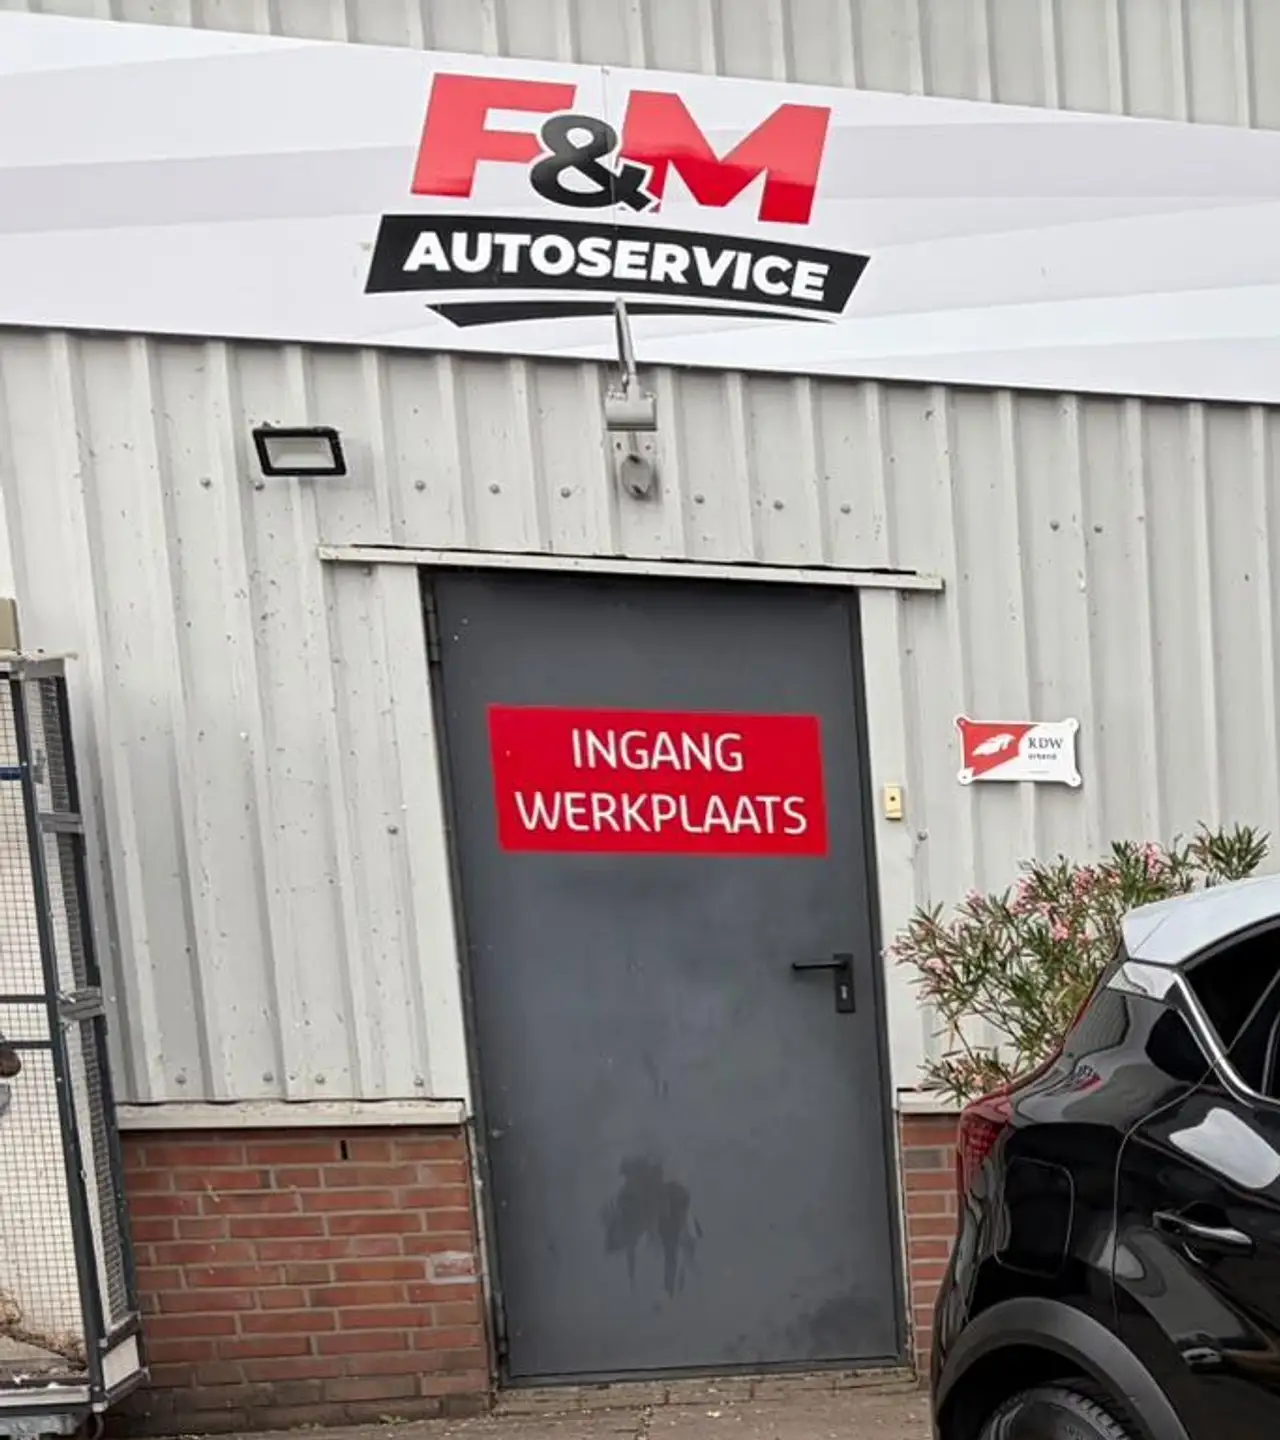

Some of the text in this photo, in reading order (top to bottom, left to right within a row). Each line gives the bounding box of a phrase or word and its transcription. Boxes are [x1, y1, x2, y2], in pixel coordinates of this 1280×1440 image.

[411, 73, 831, 225] F&M
[403, 230, 830, 302] AUTOSERVICE
[571, 728, 744, 773] INGANG
[514, 791, 808, 836] WERKPLAATS
